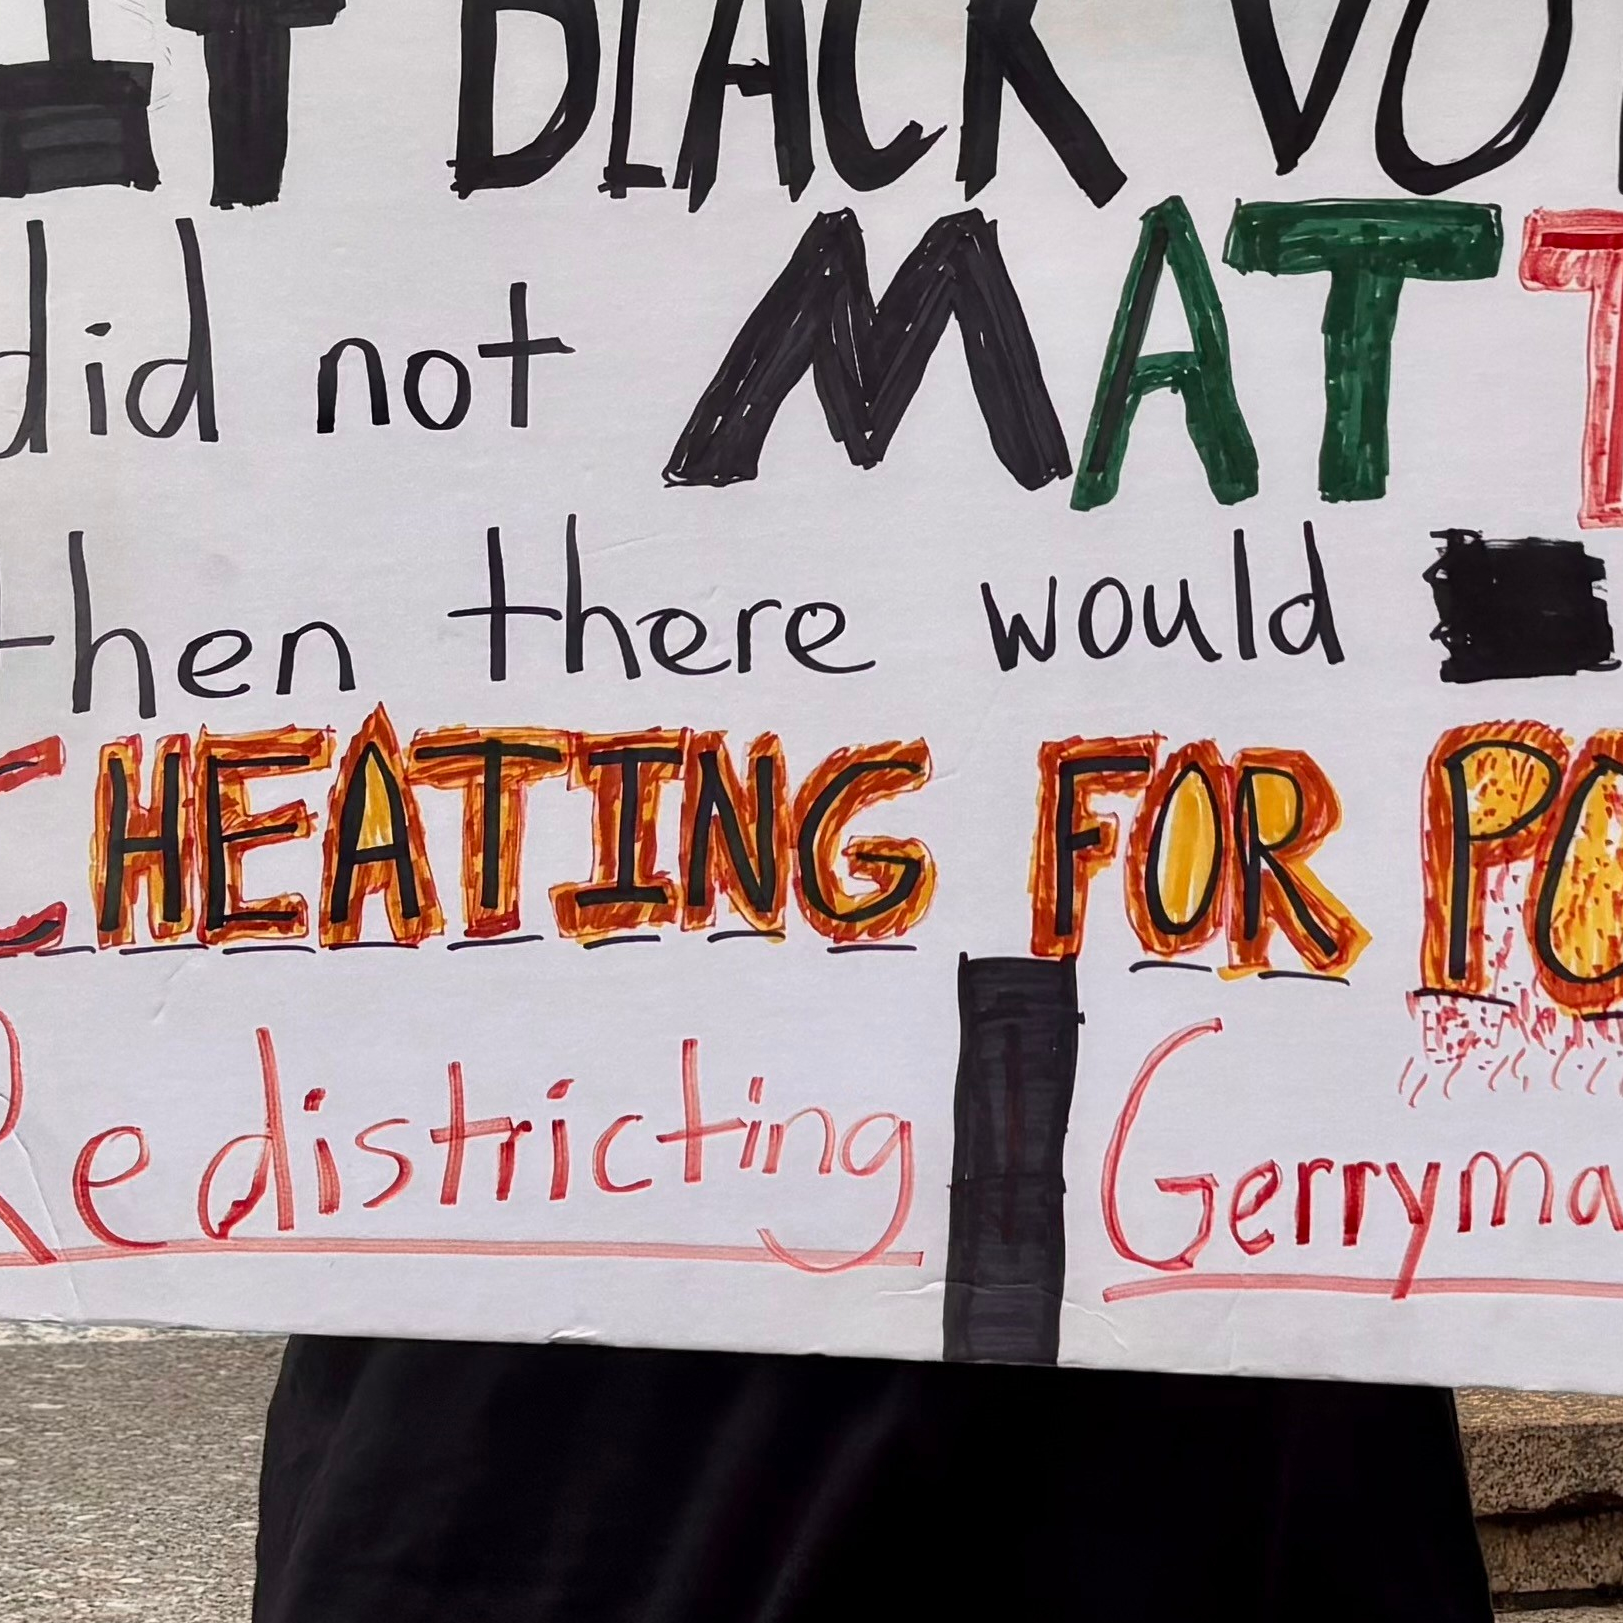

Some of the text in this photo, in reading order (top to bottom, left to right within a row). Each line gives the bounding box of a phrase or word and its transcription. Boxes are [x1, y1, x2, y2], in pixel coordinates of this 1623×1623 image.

[315, 281, 575, 433] not
[447, 513, 877, 683] there
[979, 519, 1347, 671] would
[1029, 731, 1371, 981] FOR
